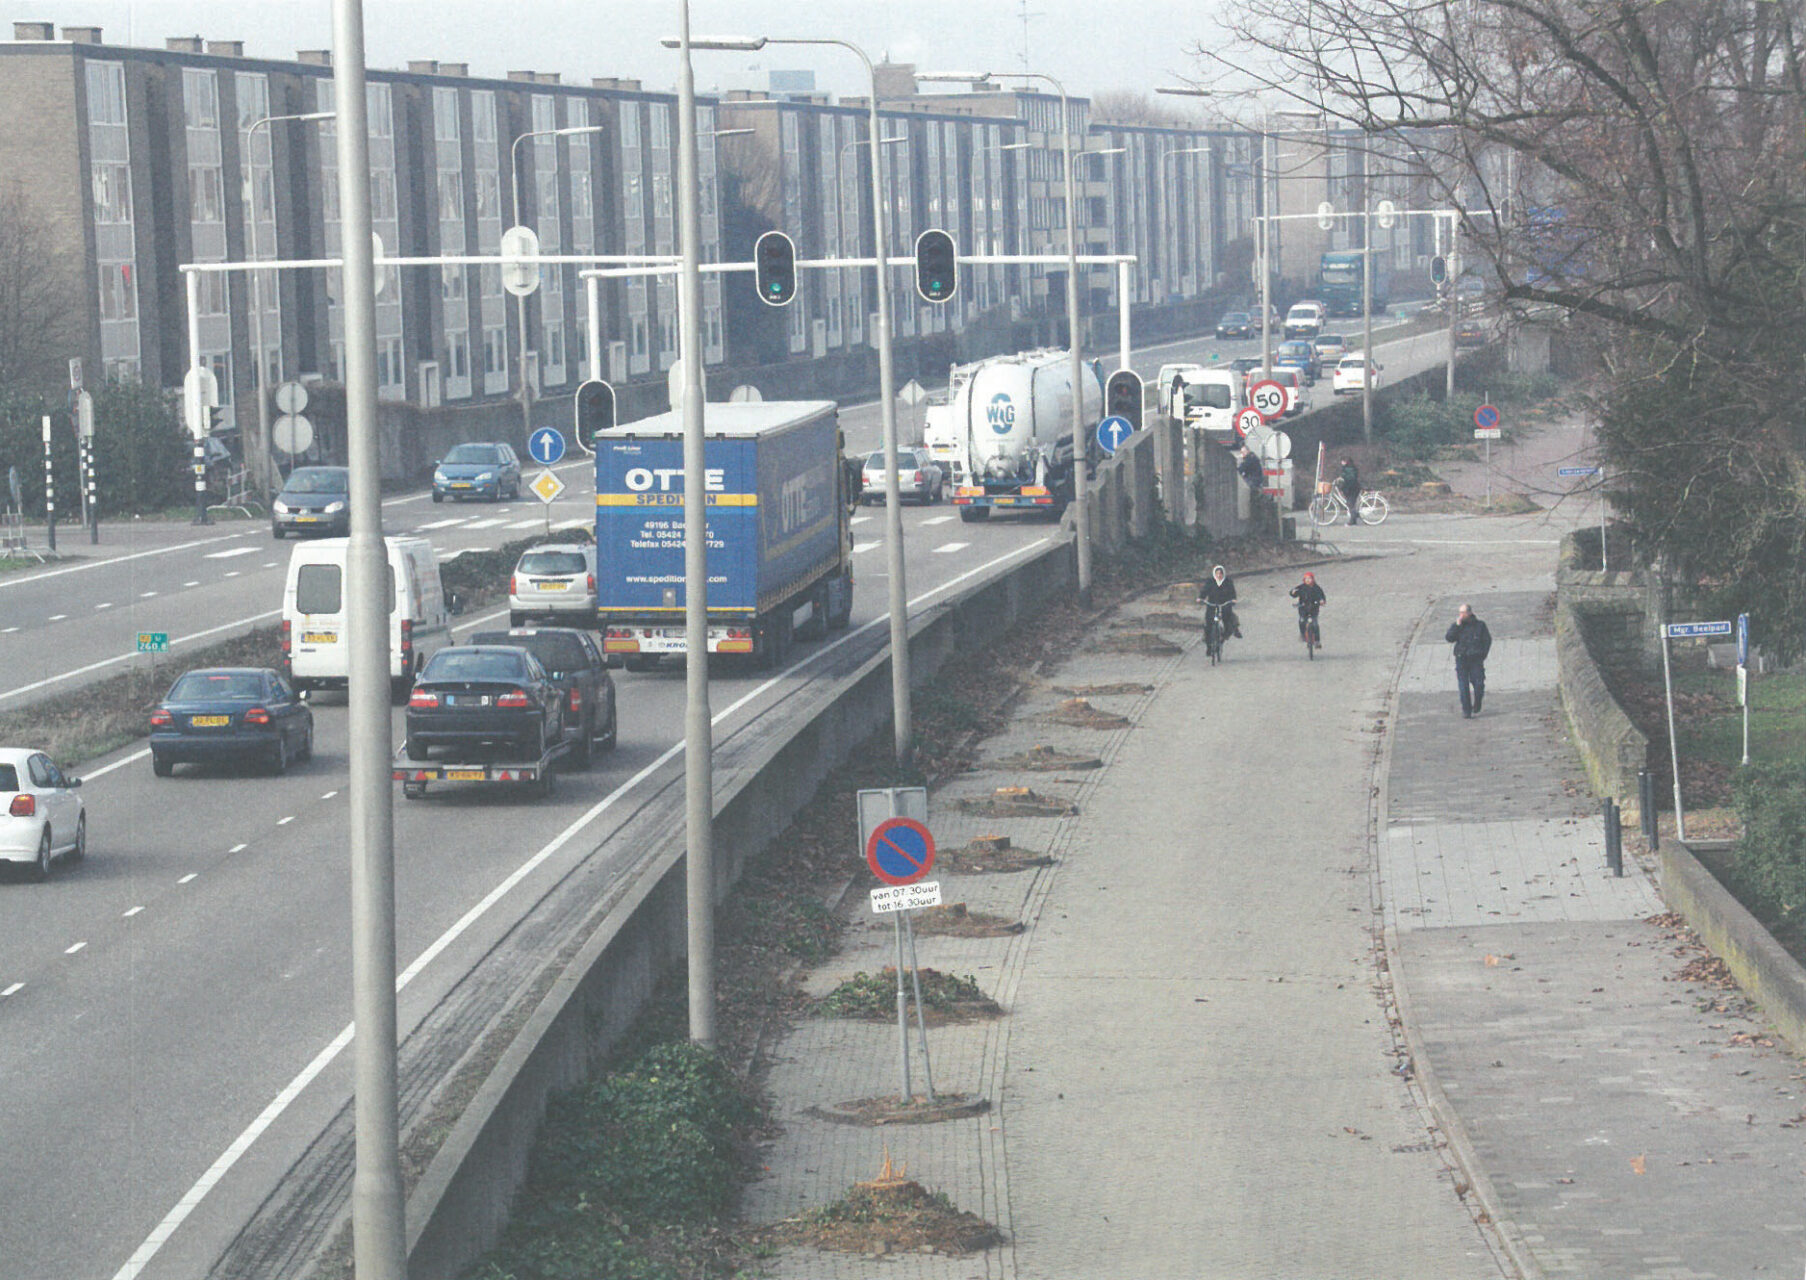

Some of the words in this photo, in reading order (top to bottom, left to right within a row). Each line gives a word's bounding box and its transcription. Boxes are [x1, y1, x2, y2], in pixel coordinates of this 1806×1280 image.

[1256, 392, 1281, 408] 50
[1242, 416, 1259, 429] 30
[636, 494, 717, 505] SPEDIN
[665, 642, 688, 650] KRO
[873, 892, 890, 900] van
[878, 902, 890, 911] tot
